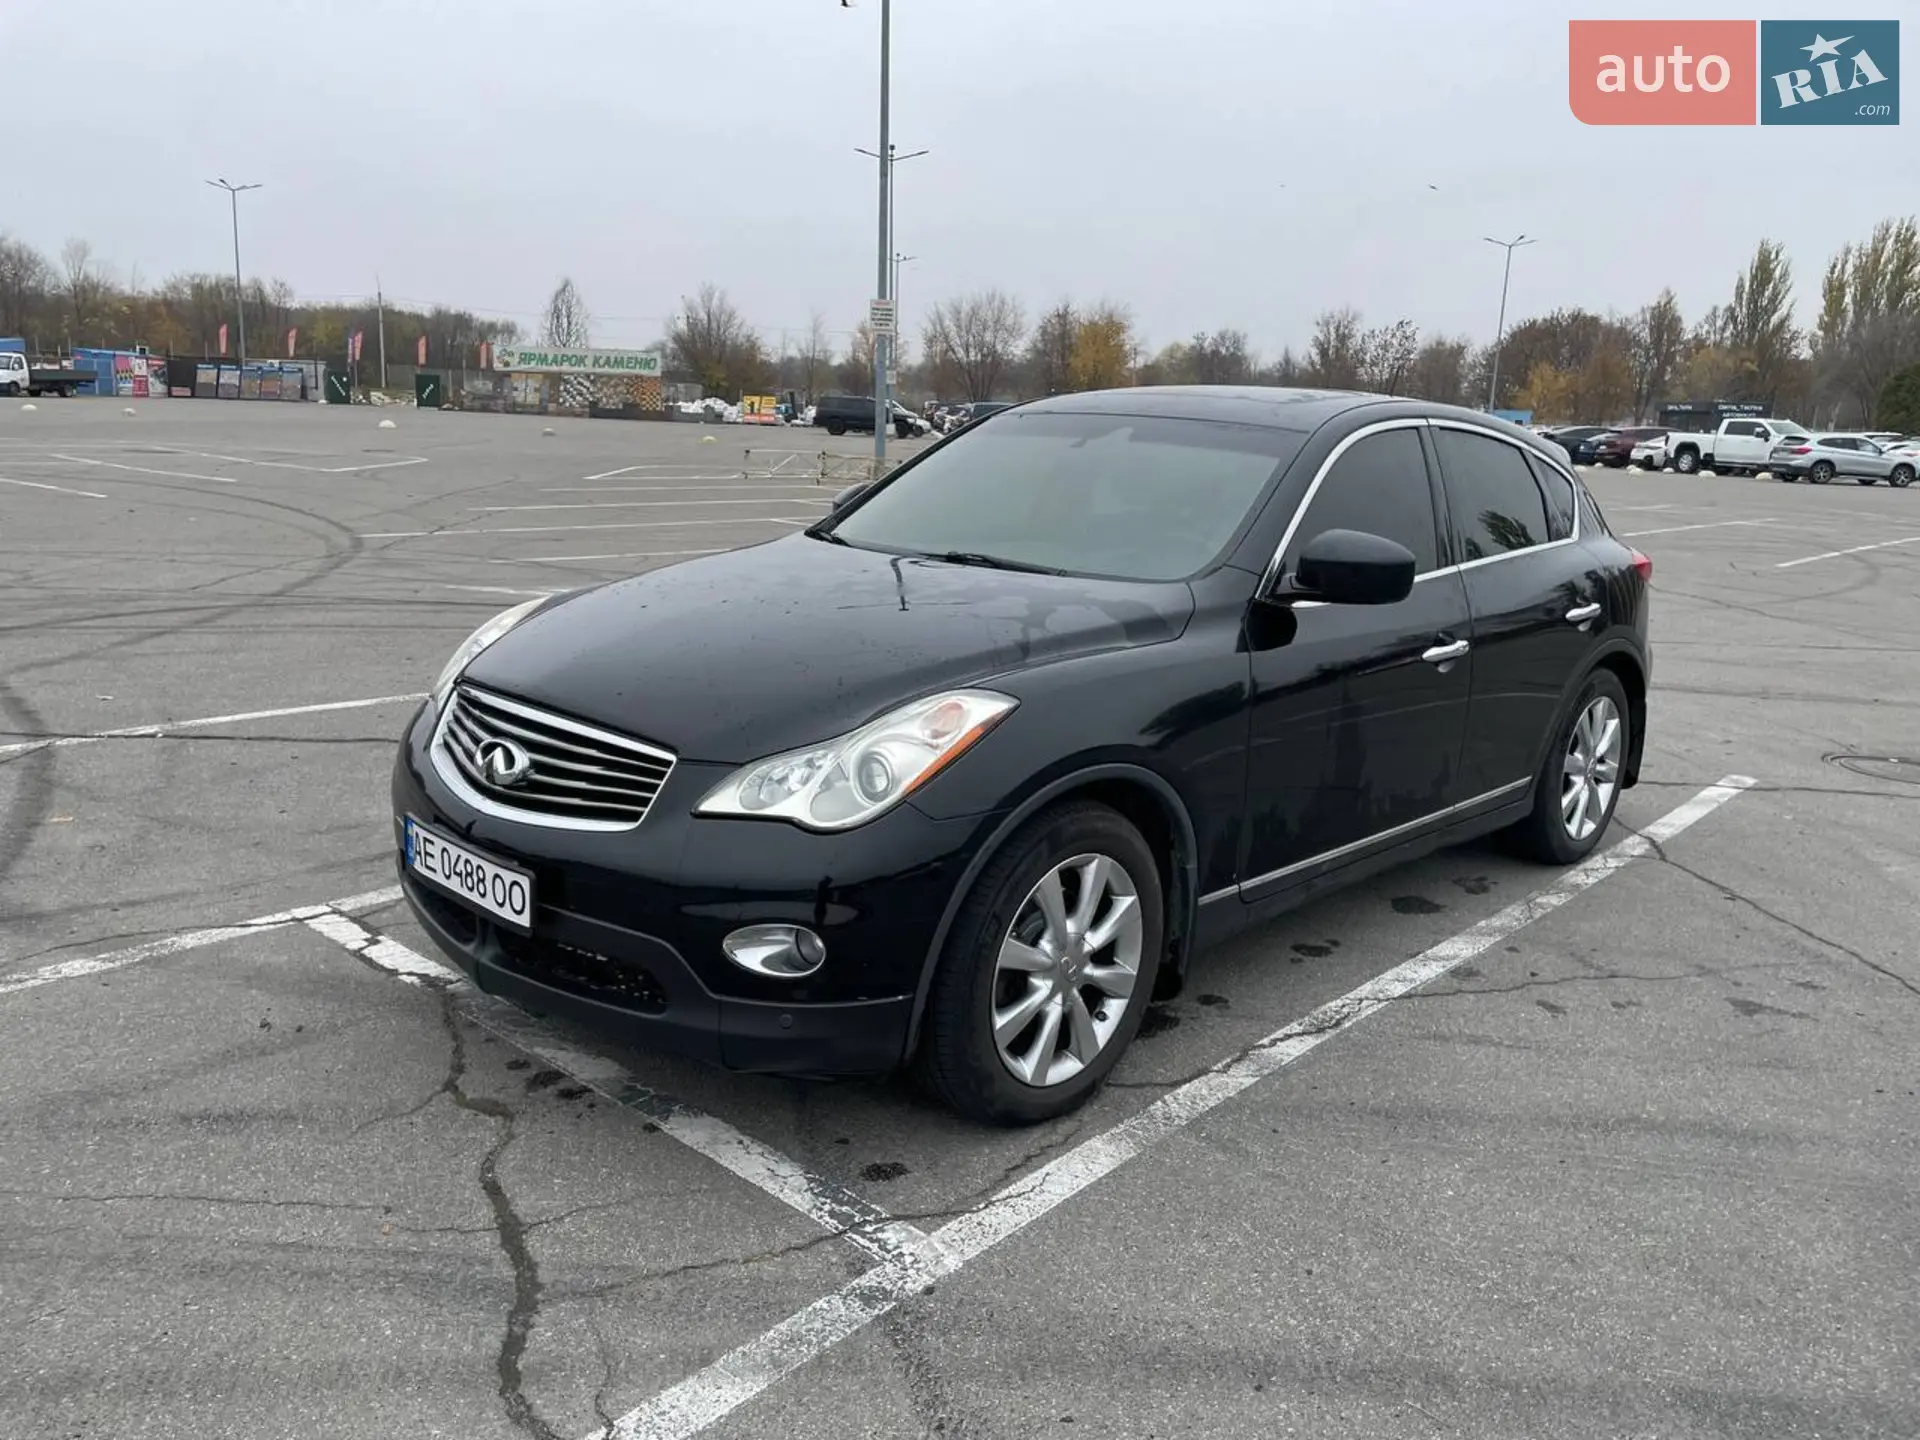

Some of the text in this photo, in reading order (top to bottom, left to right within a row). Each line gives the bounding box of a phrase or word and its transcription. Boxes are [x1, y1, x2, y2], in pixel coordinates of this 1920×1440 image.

[518, 351, 658, 371] ЯРМАРОК КАМЕНЮ
[414, 831, 526, 916] AE 0488 OO
